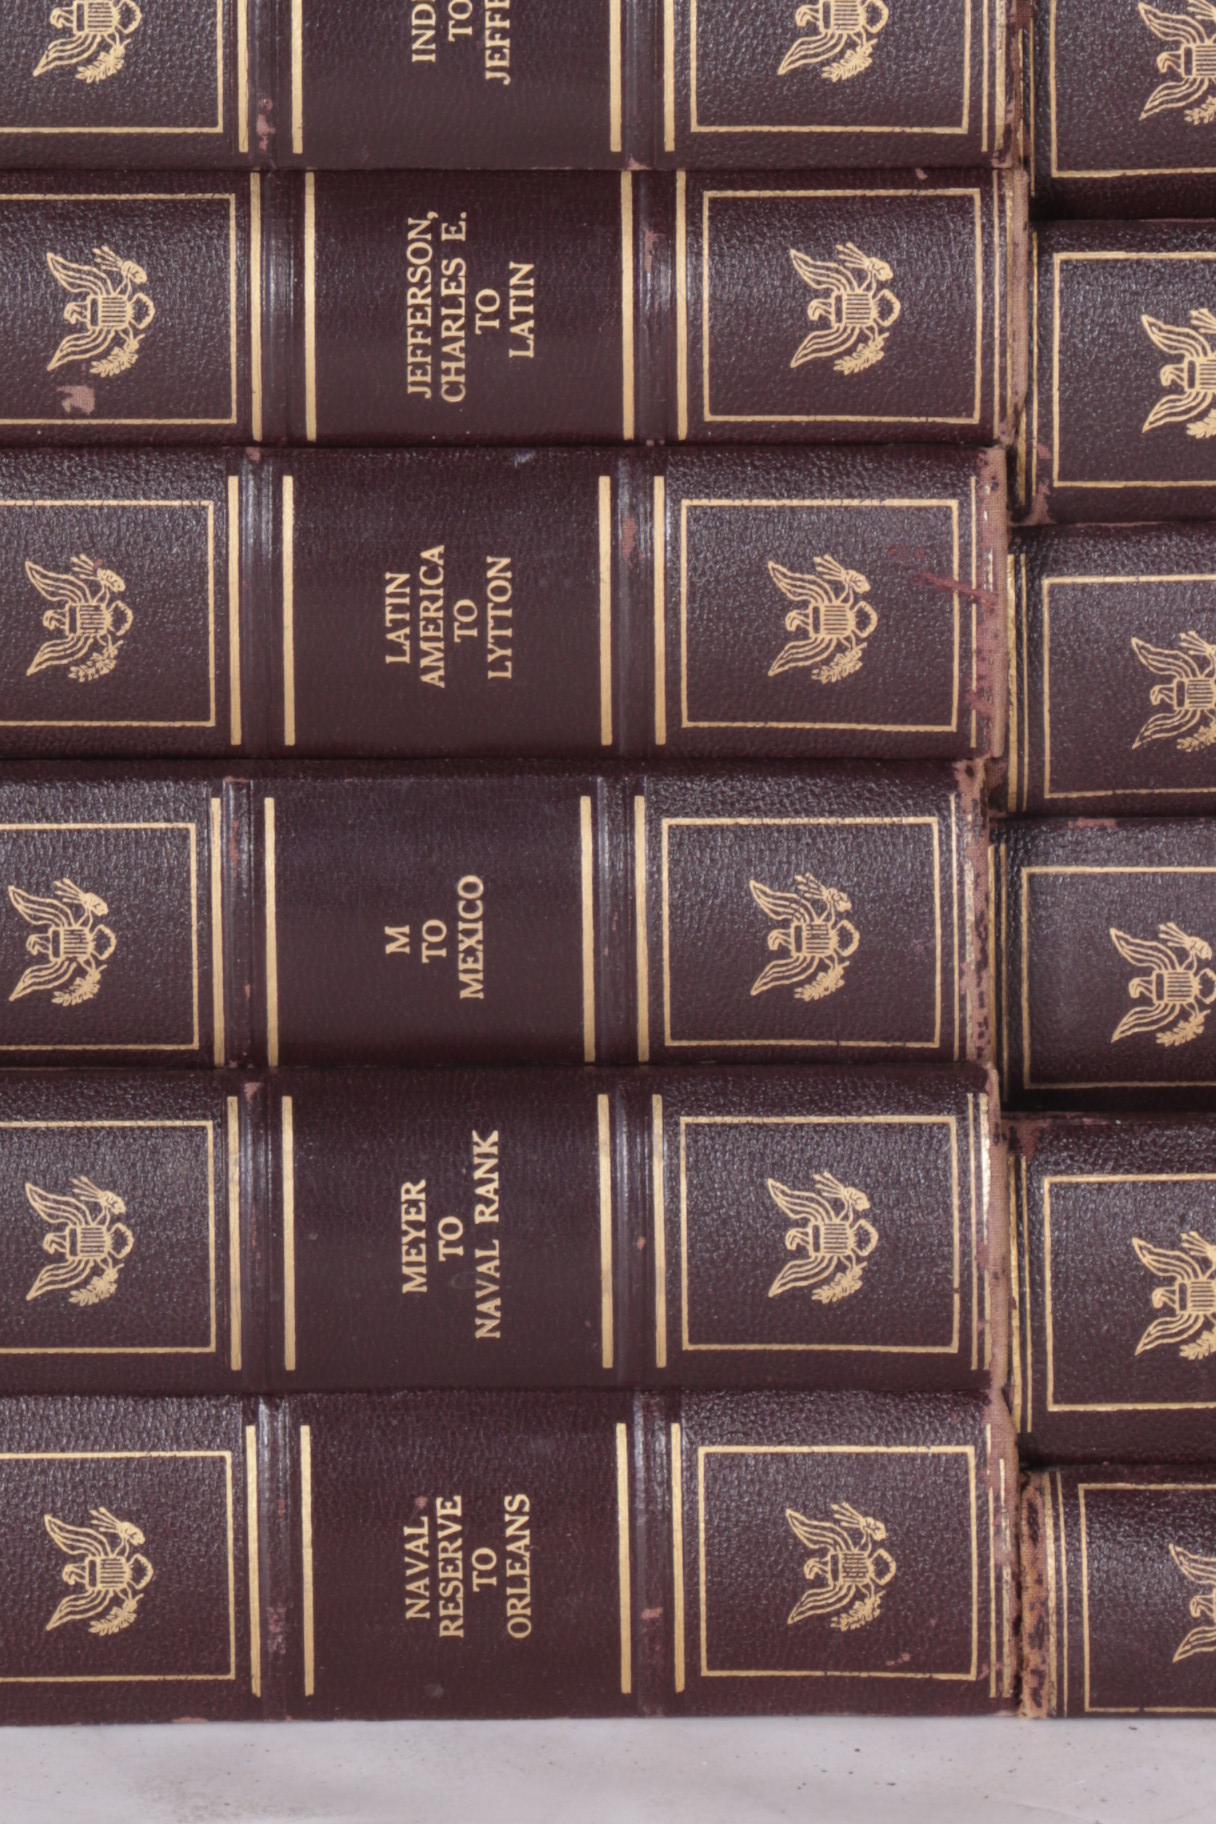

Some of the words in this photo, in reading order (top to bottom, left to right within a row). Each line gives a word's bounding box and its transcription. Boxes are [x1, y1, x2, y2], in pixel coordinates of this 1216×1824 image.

[441, 211, 467, 242] E.
[406, 211, 439, 399] JEFFERSON,
[440, 257, 466, 403] CHARLES
[475, 288, 500, 335] TO
[509, 261, 535, 359] LATIN
[385, 573, 411, 665] LATIN
[418, 544, 446, 688] AMERICA
[452, 598, 479, 644] TO
[486, 556, 513, 679] LYTTON
[385, 925, 411, 955] M
[421, 918, 448, 964] TO
[458, 875, 485, 1000] MEXICO
[472, 1130, 499, 1225] RANK
[401, 1179, 428, 1294] MEYER
[437, 1216, 465, 1262] TO
[475, 1239, 501, 1339] NAVAL
[403, 1516, 431, 1620] NAVAL
[435, 1495, 464, 1638] RESERVE
[471, 1547, 497, 1592] TO
[504, 1494, 532, 1639] ORLEANS
